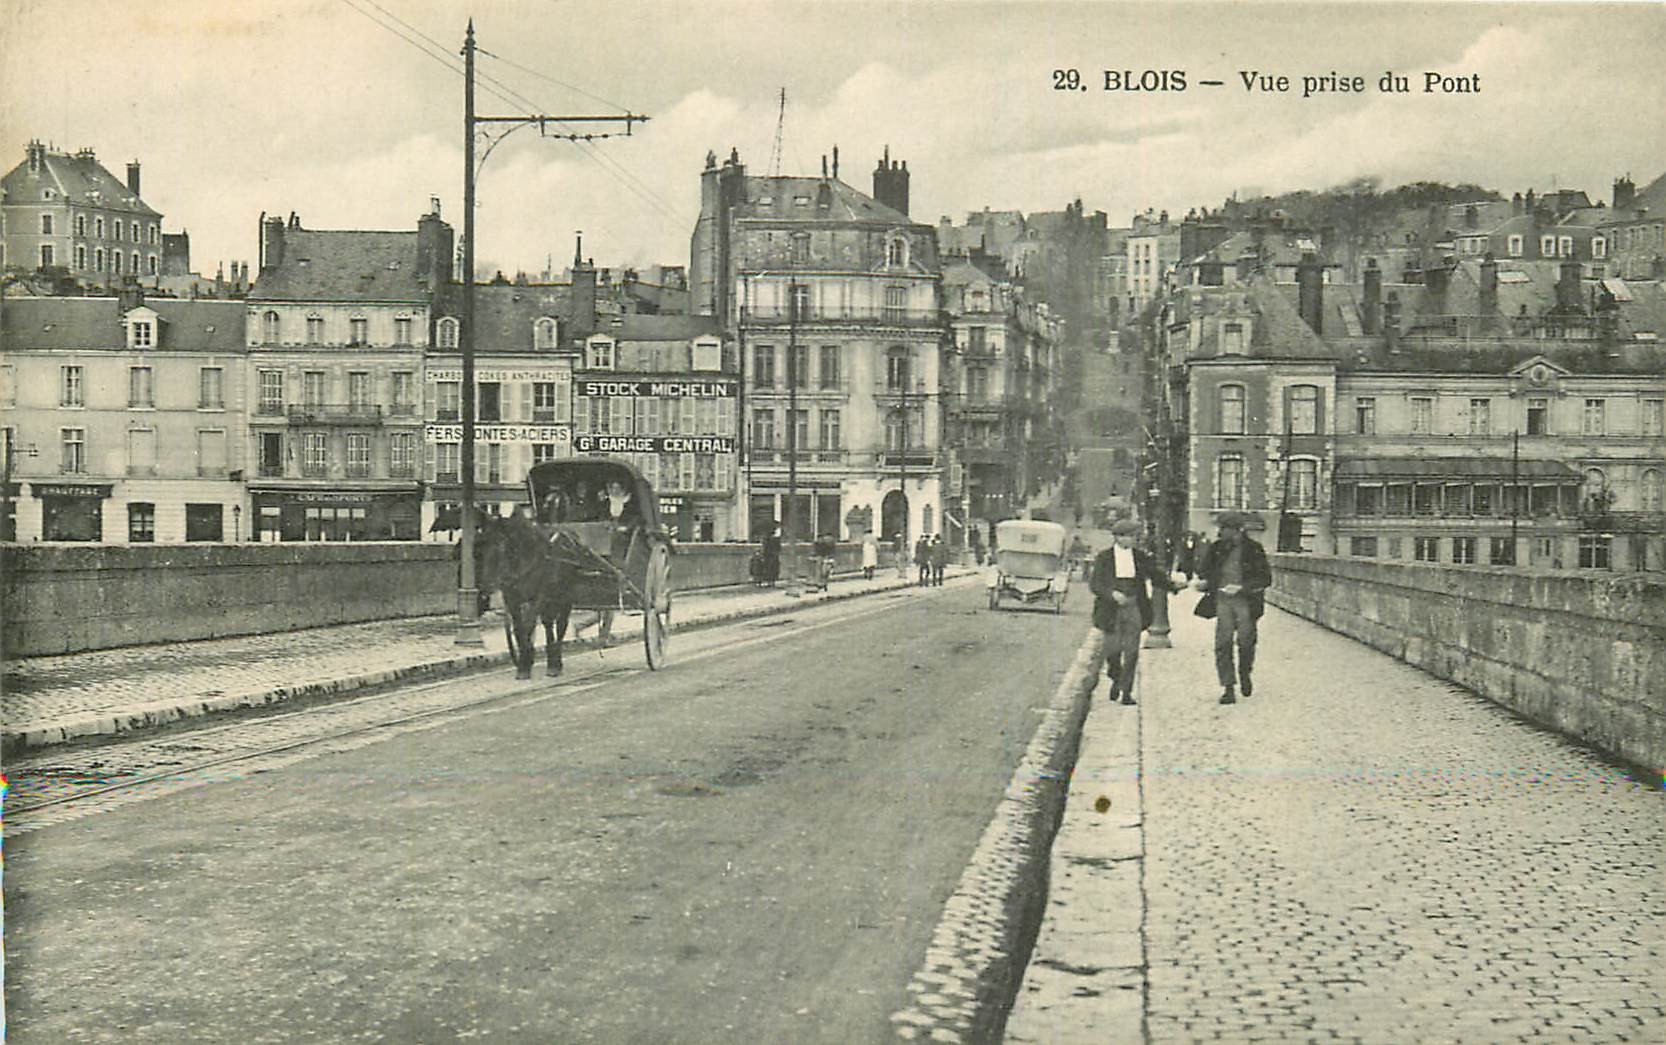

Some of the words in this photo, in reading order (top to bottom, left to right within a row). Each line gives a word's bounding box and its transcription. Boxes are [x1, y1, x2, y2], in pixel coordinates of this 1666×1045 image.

[586, 383, 640, 395] STOCK
[651, 383, 728, 396] MICHELIN
[599, 438, 654, 450] GARAGE
[663, 438, 732, 452] CENTRAL
